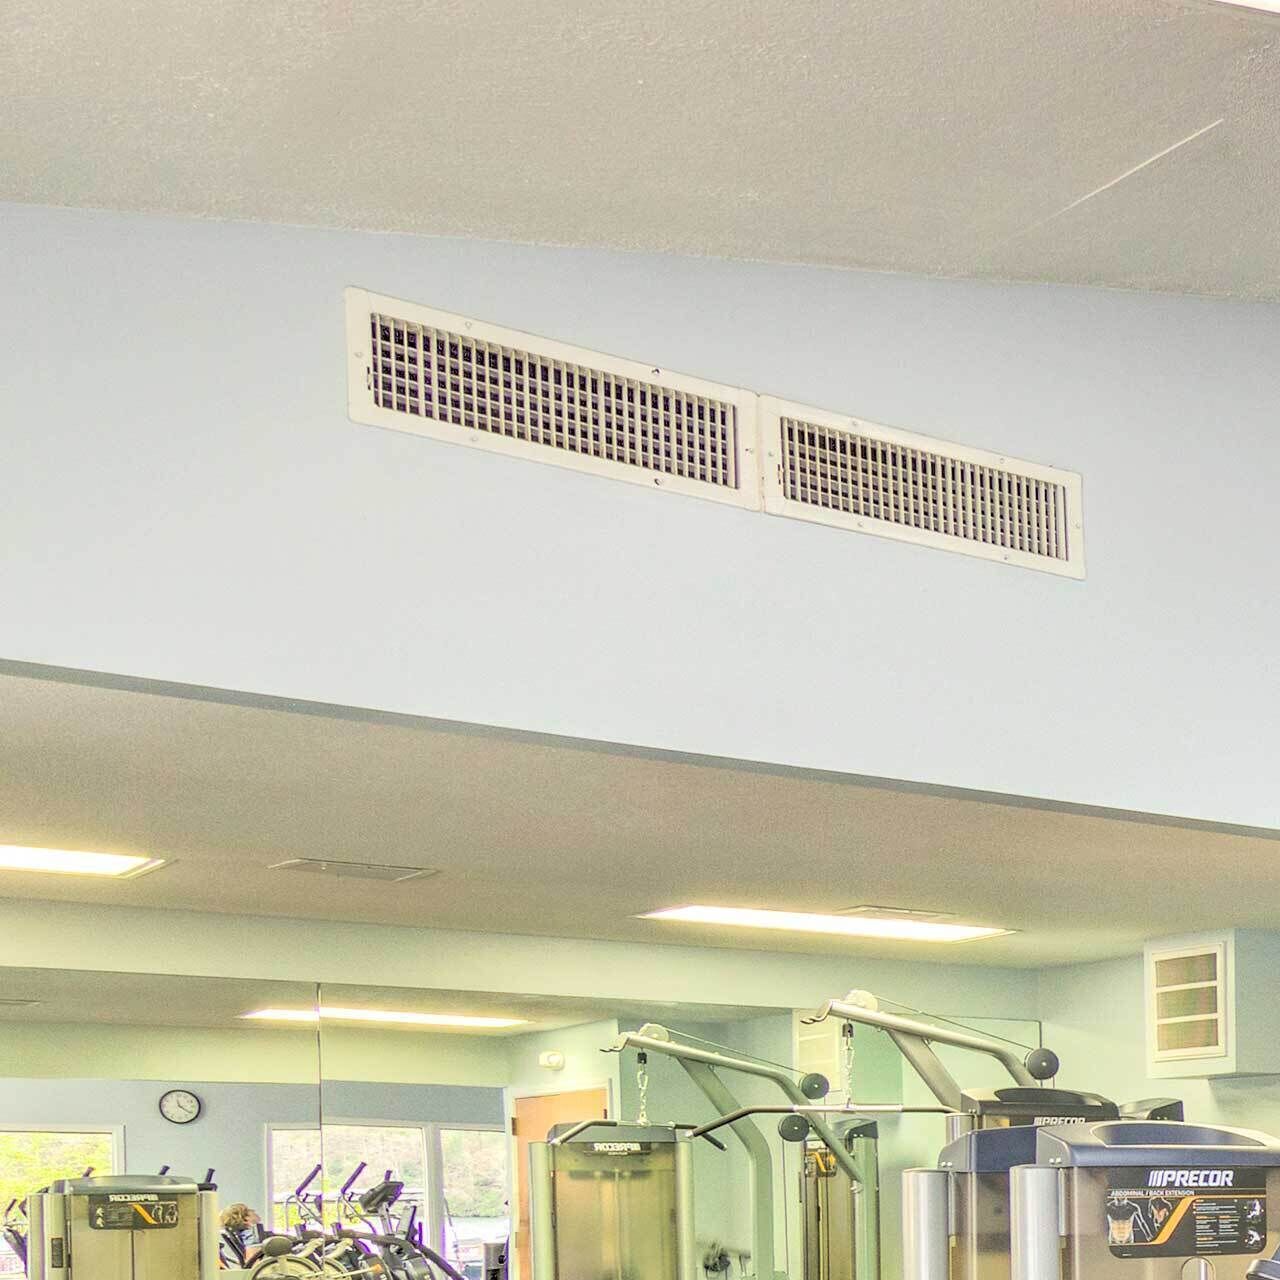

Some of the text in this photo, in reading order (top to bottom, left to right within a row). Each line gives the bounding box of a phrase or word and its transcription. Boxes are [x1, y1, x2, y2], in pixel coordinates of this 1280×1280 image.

[1158, 1169, 1234, 1187] PRECOR
[1110, 1189, 1145, 1197] ABDOMINAL
[1164, 1188, 1195, 1196] EXTENSION
